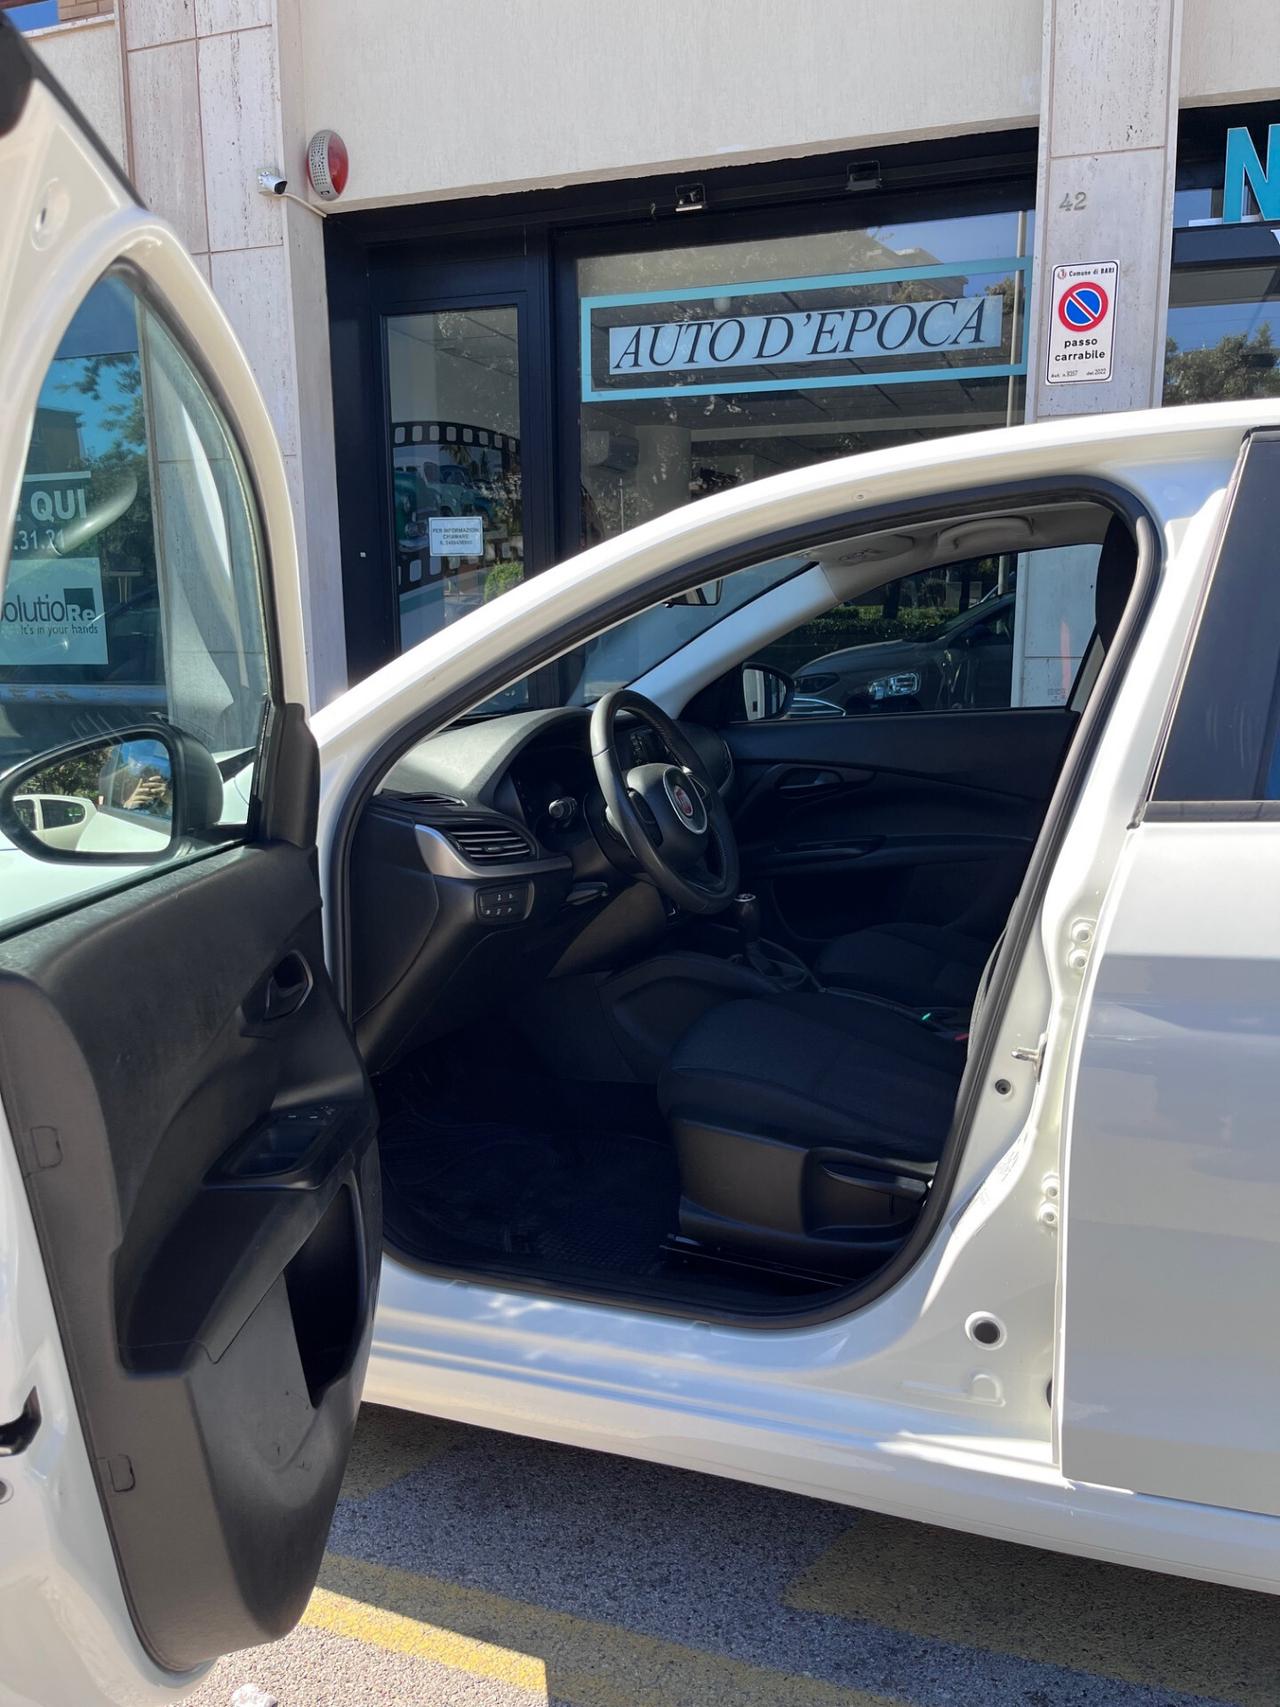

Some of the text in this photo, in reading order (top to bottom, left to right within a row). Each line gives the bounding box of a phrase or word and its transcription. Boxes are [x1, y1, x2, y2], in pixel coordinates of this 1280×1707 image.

[1058, 191, 1088, 212] 42
[1100, 267, 1115, 275] BARI
[613, 297, 986, 370] AUTO D'EPOCA
[1064, 338, 1098, 349] passo
[1054, 350, 1106, 361] carrabile
[30, 488, 87, 523] QUI
[47, 625, 70, 637] your
[71, 623, 98, 634] hands
